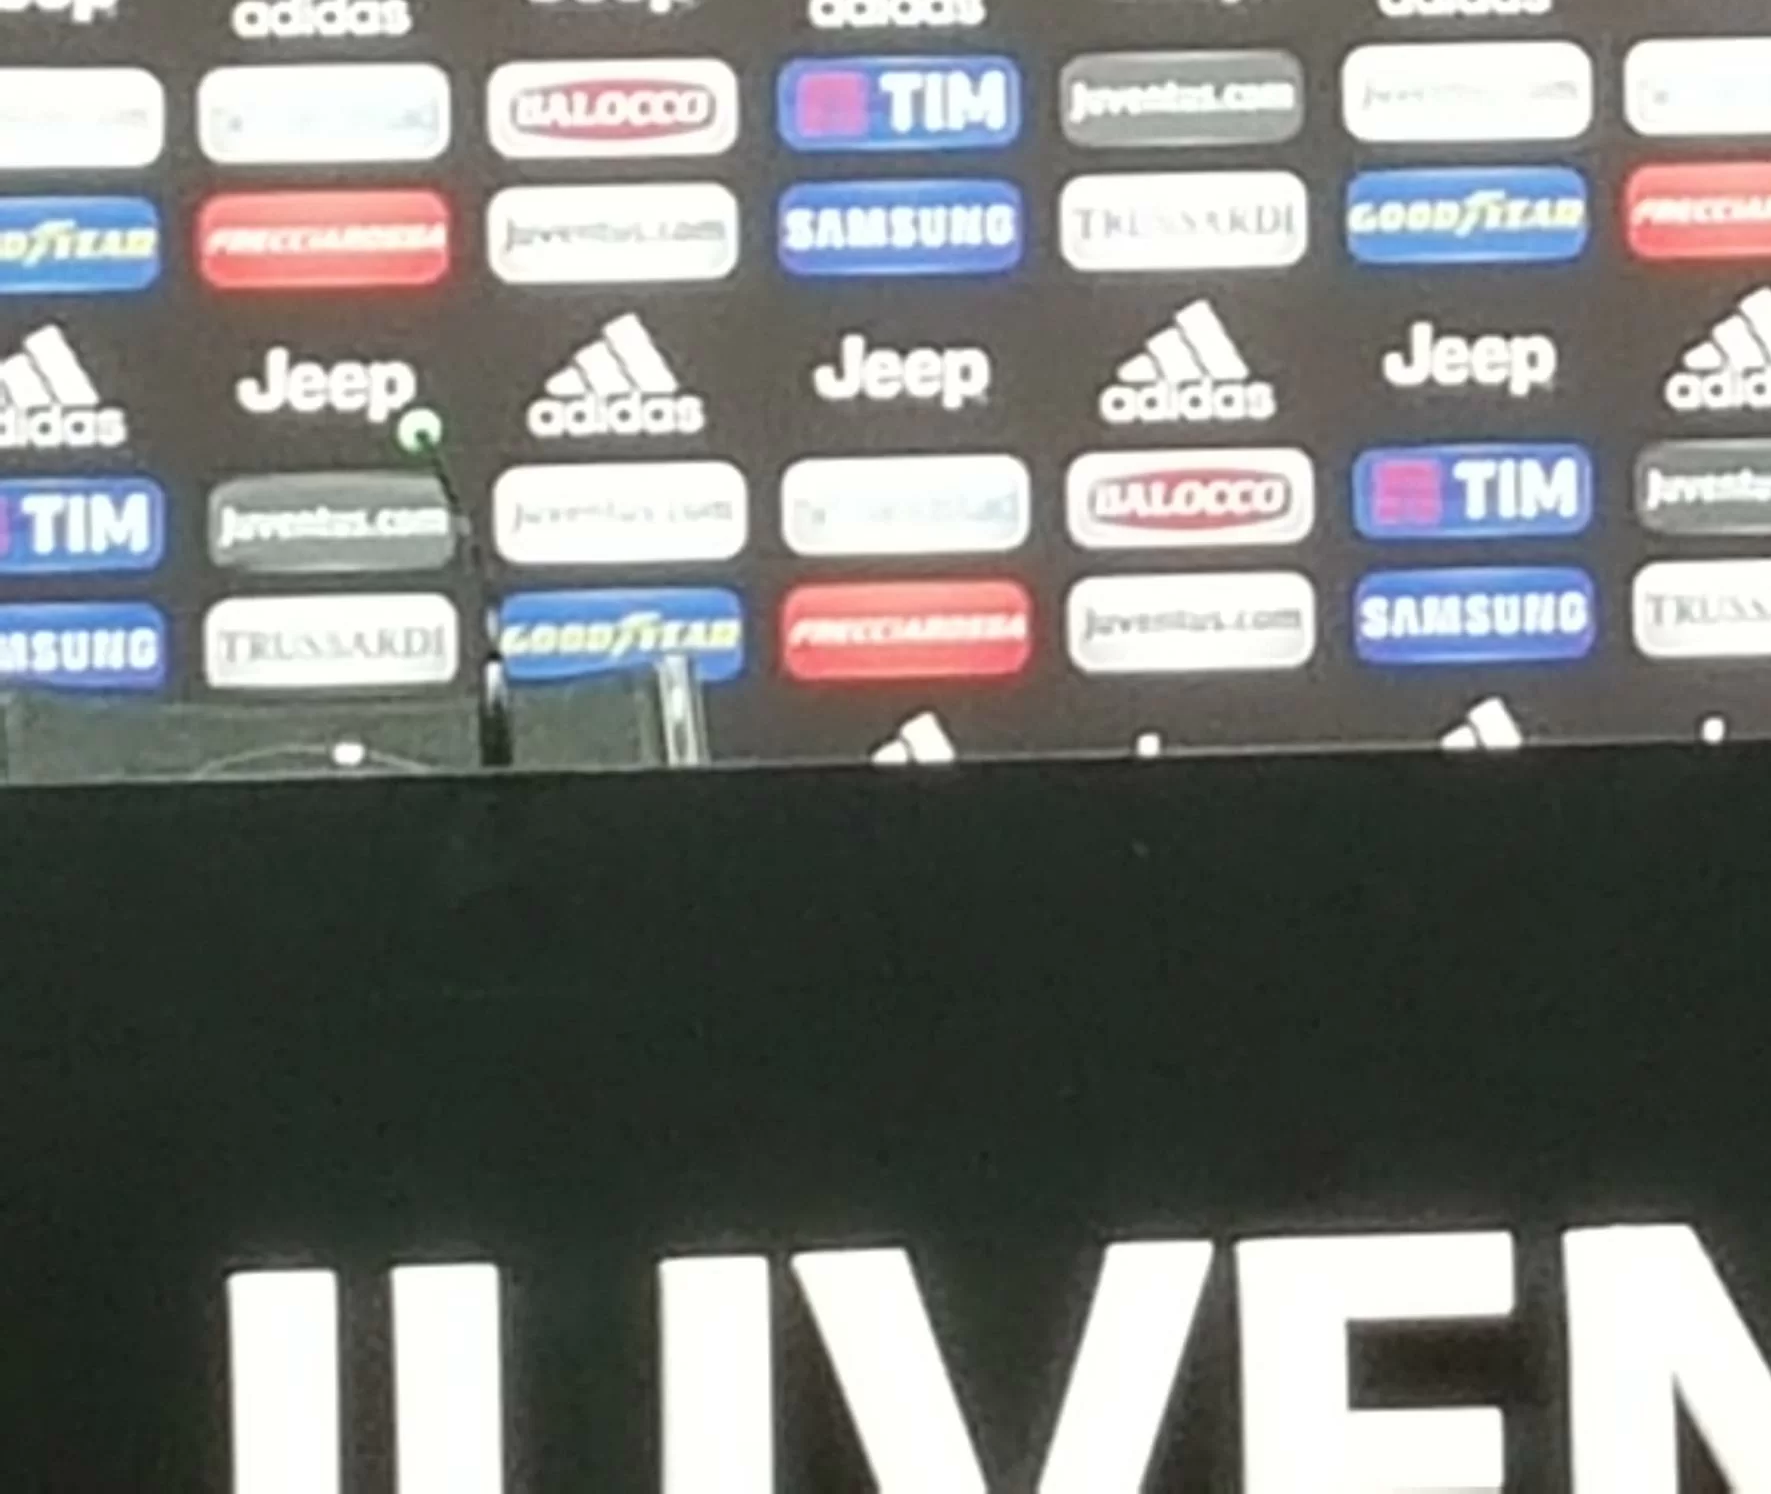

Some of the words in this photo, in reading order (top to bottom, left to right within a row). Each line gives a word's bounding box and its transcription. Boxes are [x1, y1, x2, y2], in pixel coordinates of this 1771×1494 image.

[515, 92, 710, 127] BALOCCO
[880, 71, 1007, 132] TIM
[783, 206, 1015, 251] SAMSUNG
[1347, 190, 1585, 238] GOODYEAR
[0, 218, 158, 266] DYEAR
[812, 335, 991, 408] Jeep
[1382, 322, 1558, 397] Jeep
[236, 348, 418, 422] Jeep
[1099, 381, 1277, 423] adidas
[0, 407, 128, 447] idas
[526, 394, 705, 438] adidas
[1095, 481, 1285, 516] BALOCCO
[1455, 460, 1578, 519] TIM
[22, 494, 150, 553] TIM
[512, 498, 733, 532] Juventuscom
[501, 611, 742, 657] GOODYEAR
[1360, 592, 1586, 637] SAMSUNG
[0, 627, 156, 671] MSUNG
[219, 623, 444, 660] TRUSSARDI
